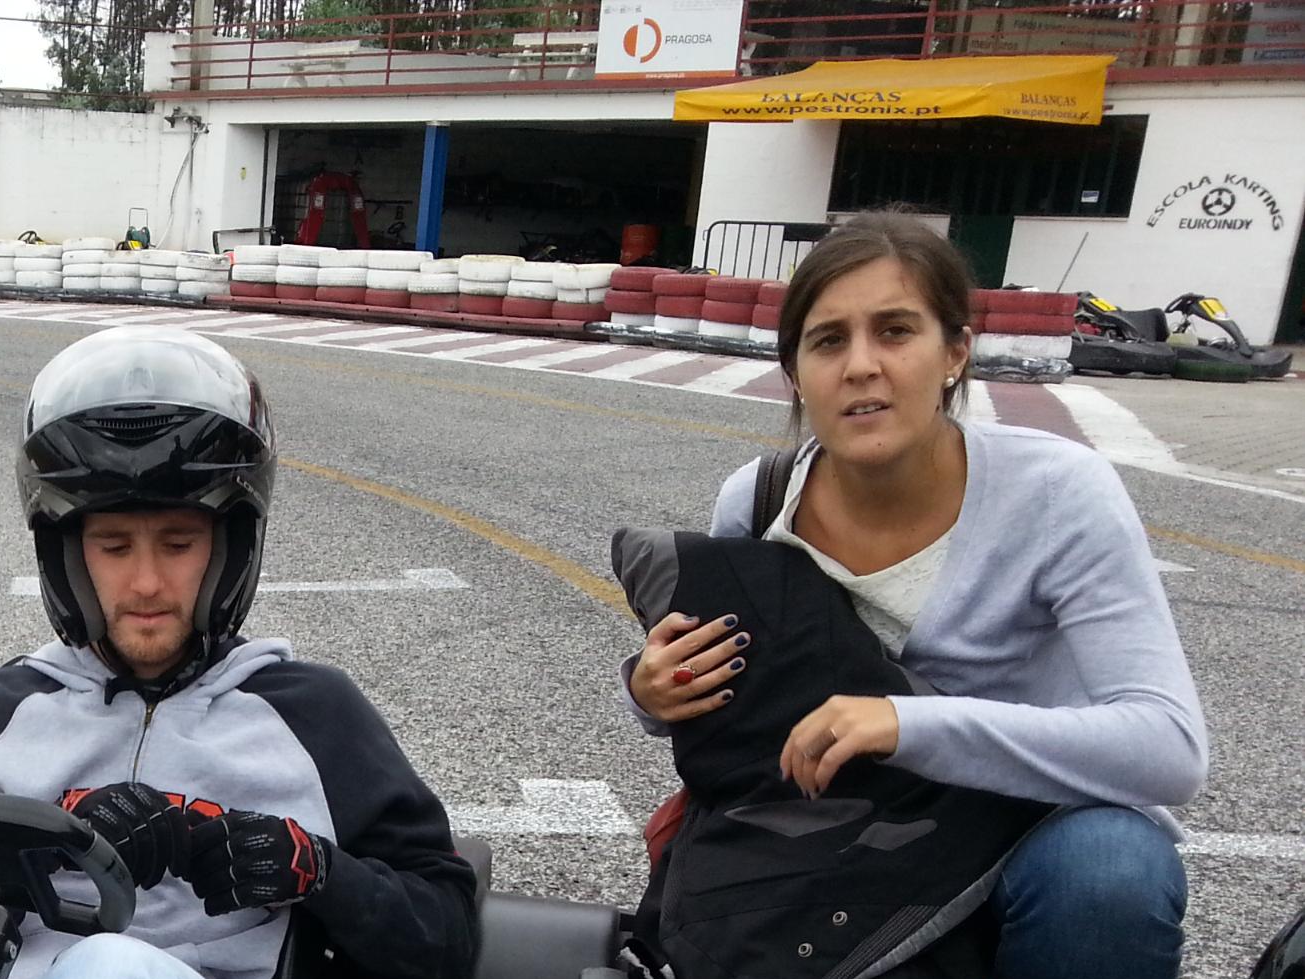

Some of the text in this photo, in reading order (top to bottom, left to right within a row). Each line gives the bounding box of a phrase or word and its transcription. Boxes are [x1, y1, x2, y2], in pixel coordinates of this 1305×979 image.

[665, 34, 712, 45] PRAGOSA
[1021, 92, 1077, 107] BALANÇAS
[722, 104, 942, 116] www.pestronix.pt
[1146, 173, 1284, 231] ESCOLA KARTING
[1178, 217, 1253, 230] EUROINDY
